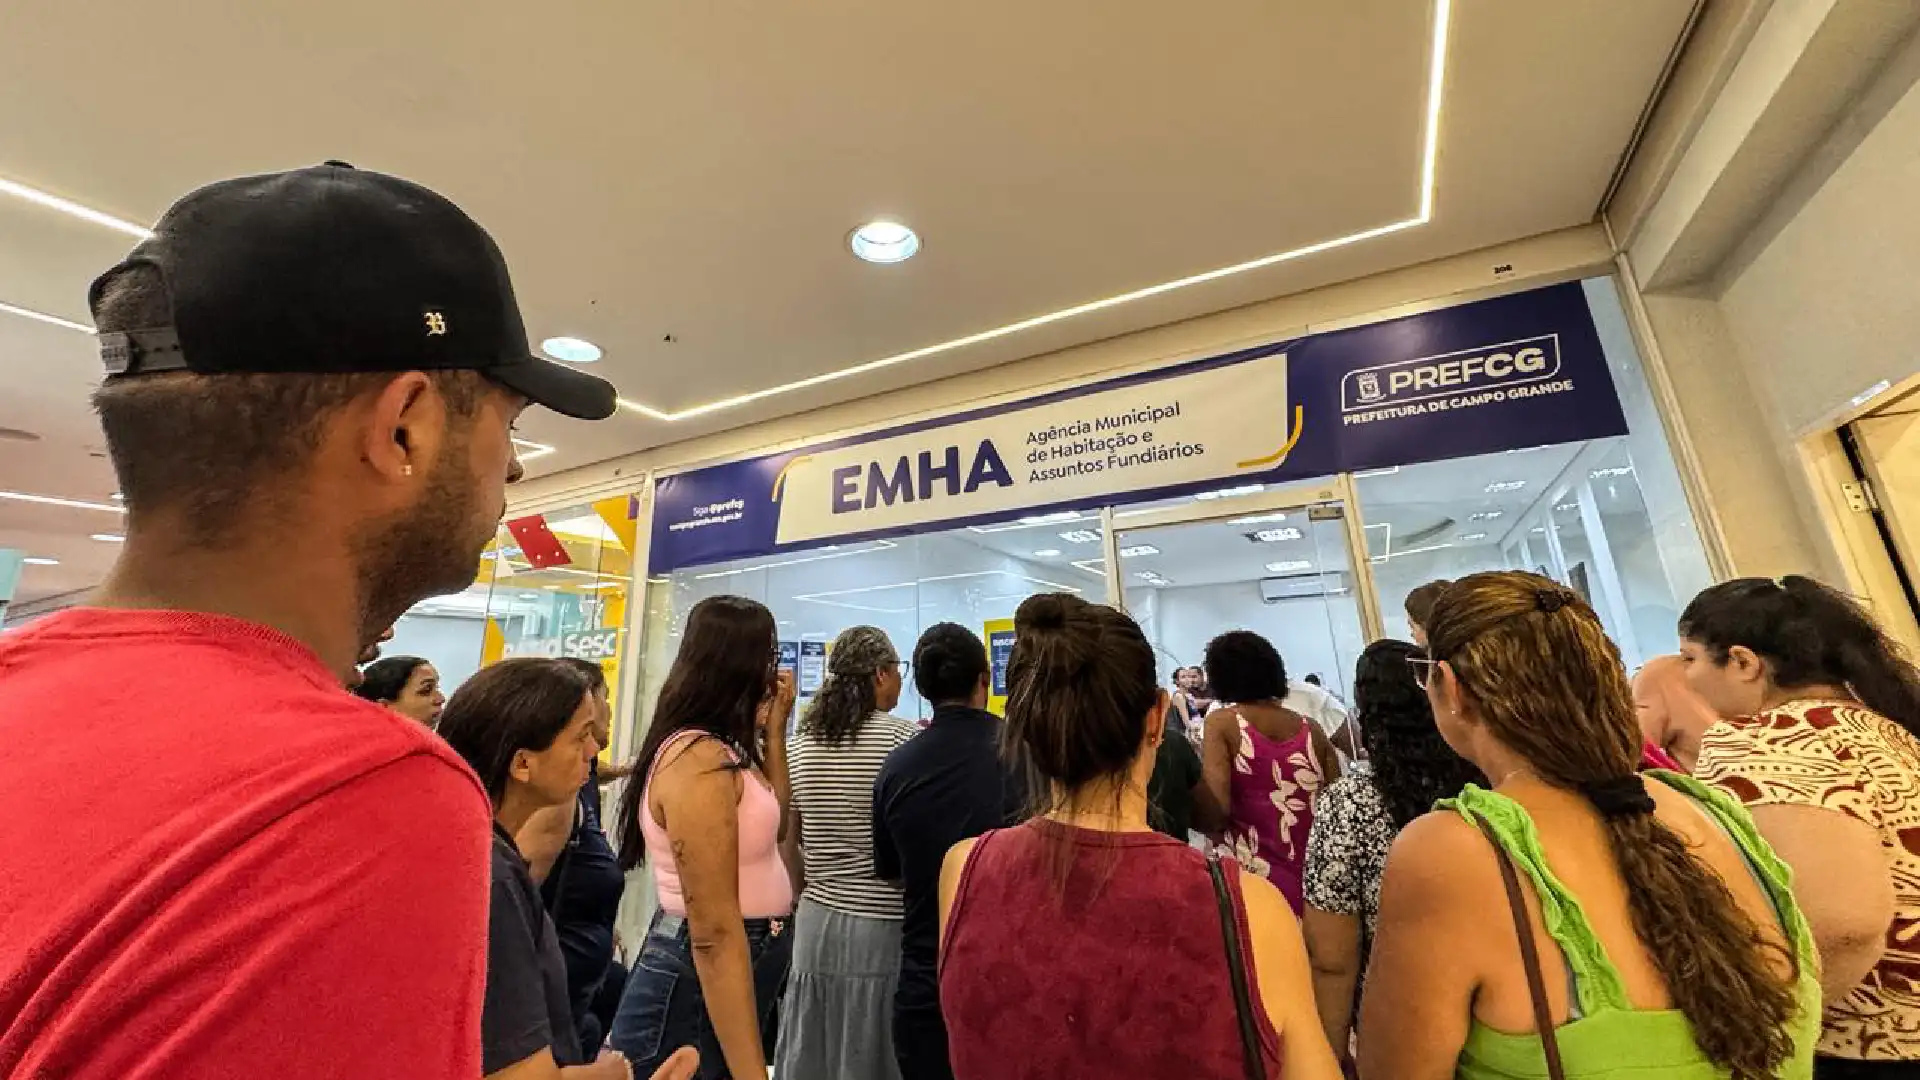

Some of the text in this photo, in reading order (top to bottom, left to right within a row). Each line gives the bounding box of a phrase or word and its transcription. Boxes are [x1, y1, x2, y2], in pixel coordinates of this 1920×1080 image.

[1390, 347, 1546, 395] PREFCG
[1026, 401, 1181, 446] Agência Municipal
[1343, 379, 1574, 426] PREFEITURA DE CAMPO GRANDE
[1026, 430, 1153, 463] de Habitação e
[1029, 441, 1205, 484] Assuntos Fundiários
[831, 438, 1014, 514] EMHA
